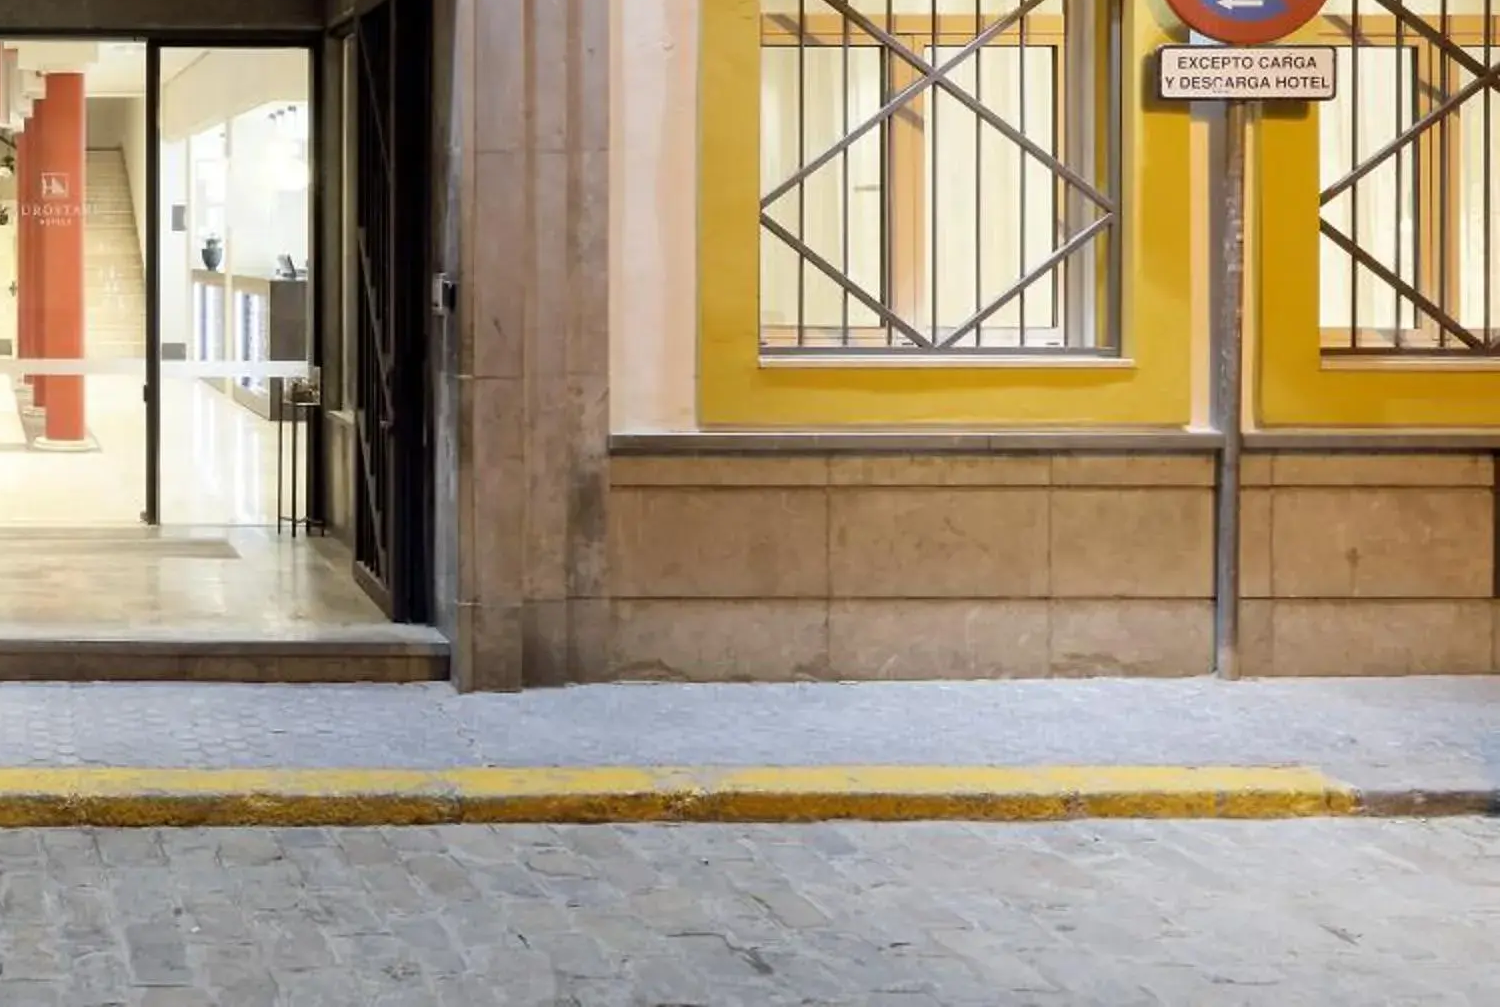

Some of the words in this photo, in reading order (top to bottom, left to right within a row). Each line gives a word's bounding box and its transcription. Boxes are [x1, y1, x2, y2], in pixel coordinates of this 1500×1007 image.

[1177, 55, 1253, 70] EXCEPTO
[1257, 55, 1318, 70] CARGA
[1164, 75, 1176, 90] Y
[1179, 75, 1272, 91] DESCARGA
[1275, 76, 1331, 90] HOTEL
